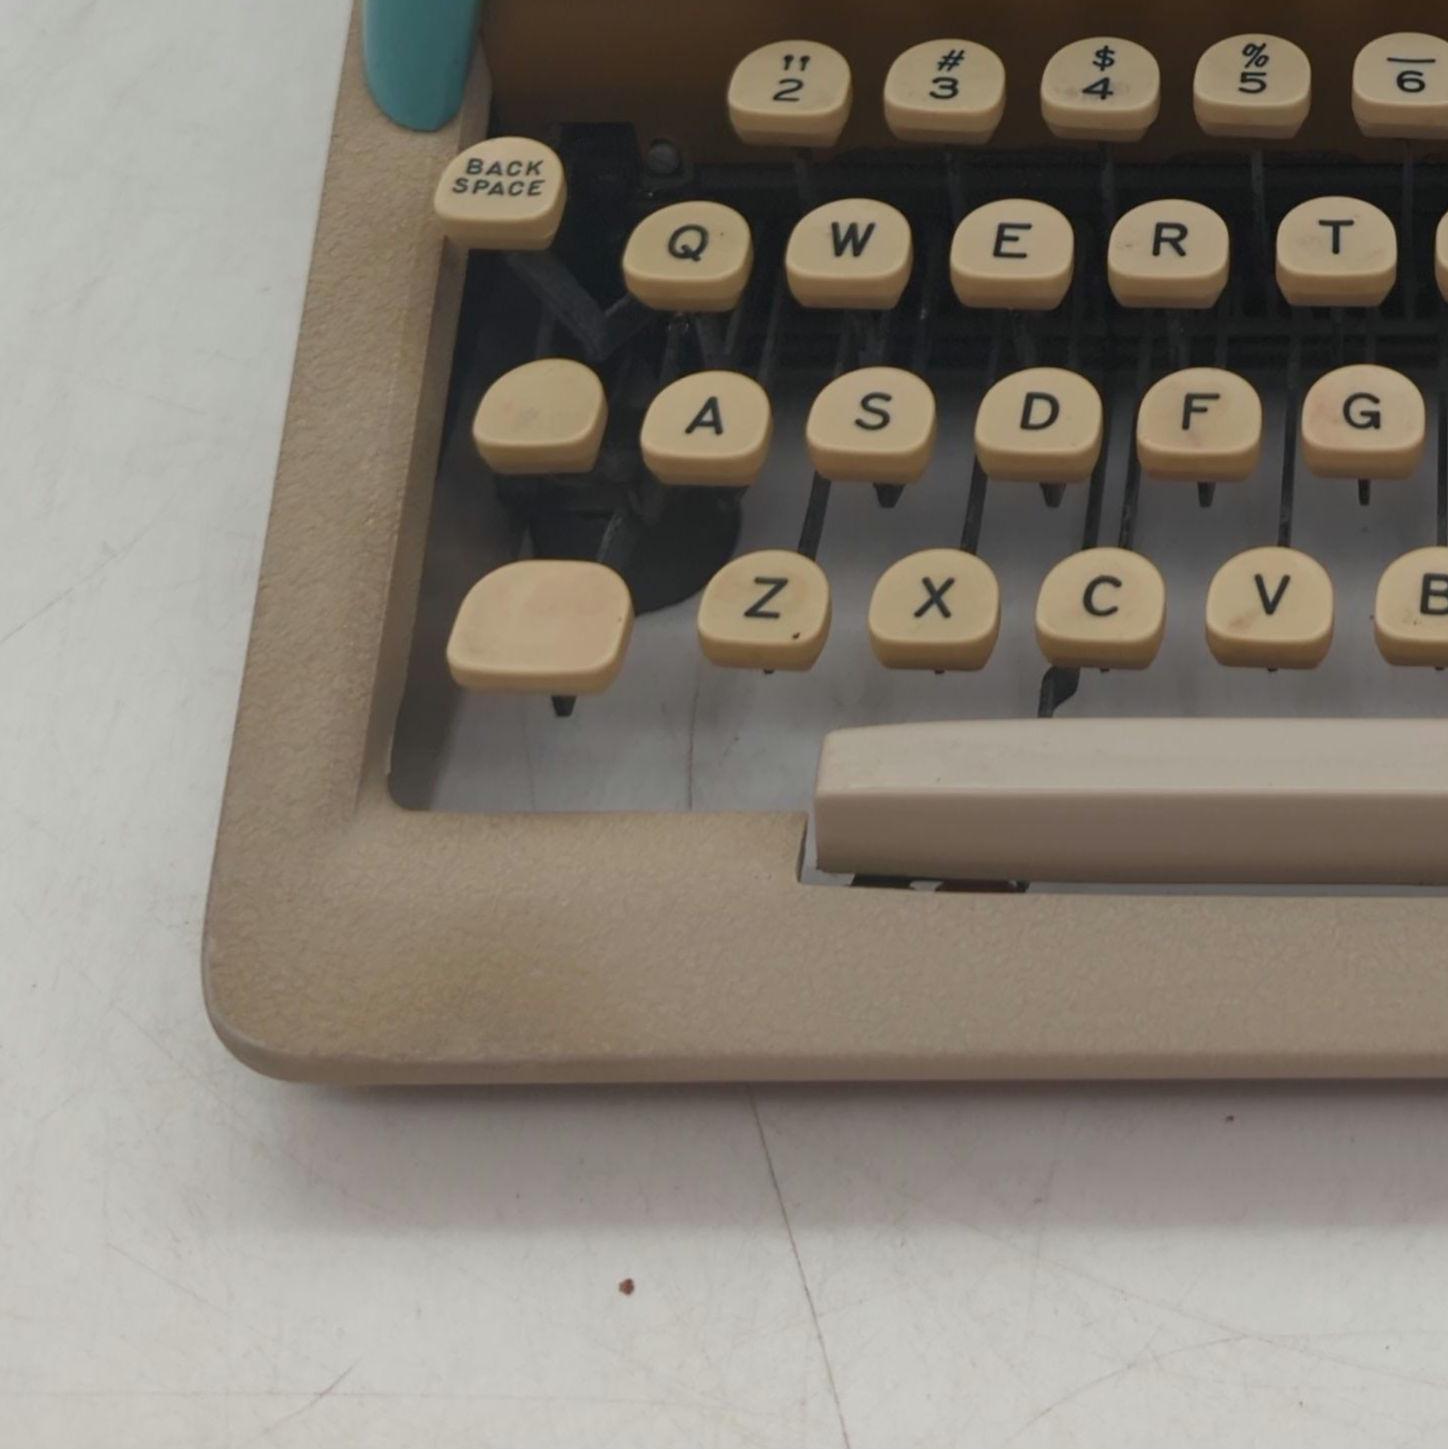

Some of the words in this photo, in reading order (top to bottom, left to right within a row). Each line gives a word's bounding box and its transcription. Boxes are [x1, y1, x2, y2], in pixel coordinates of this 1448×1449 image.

[938, 50, 965, 71] #
[1093, 45, 1115, 71] $
[1242, 43, 1269, 68] %
[773, 78, 804, 102] 2
[929, 77, 958, 99] 3
[1082, 77, 1114, 100] 4
[1238, 71, 1267, 94] 5
[1396, 70, 1425, 93] 6
[466, 158, 542, 177] BACK
[452, 177, 545, 196] SPACE
[668, 225, 708, 262] Q
[831, 222, 875, 257] W
[993, 223, 1032, 259] E
[1152, 222, 1188, 257] R
[1319, 220, 1354, 254] T
[685, 397, 723, 435] A
[855, 392, 892, 431] S
[1020, 392, 1060, 430] D
[1182, 393, 1220, 430] F
[1343, 393, 1381, 429] G
[744, 577, 788, 619] Z
[914, 577, 955, 618] X
[1083, 575, 1122, 617] C
[1254, 574, 1290, 615] V
